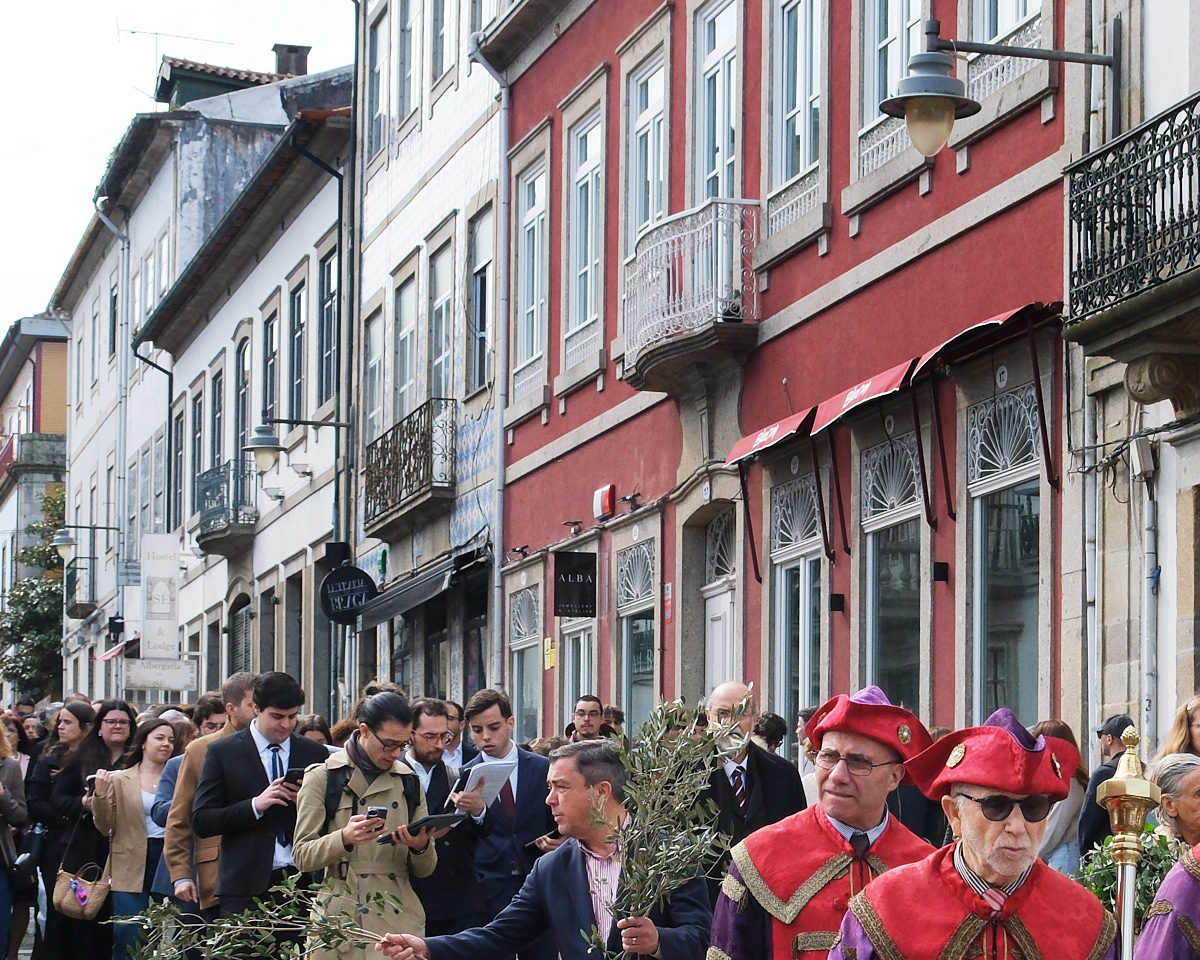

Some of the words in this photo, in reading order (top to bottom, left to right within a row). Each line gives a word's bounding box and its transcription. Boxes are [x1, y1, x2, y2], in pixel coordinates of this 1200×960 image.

[147, 551, 177, 561] Hostel
[558, 573, 593, 583] ALBA
[157, 627, 165, 637] &
[147, 640, 177, 652] Lodge
[140, 661, 181, 671] Albergaria
